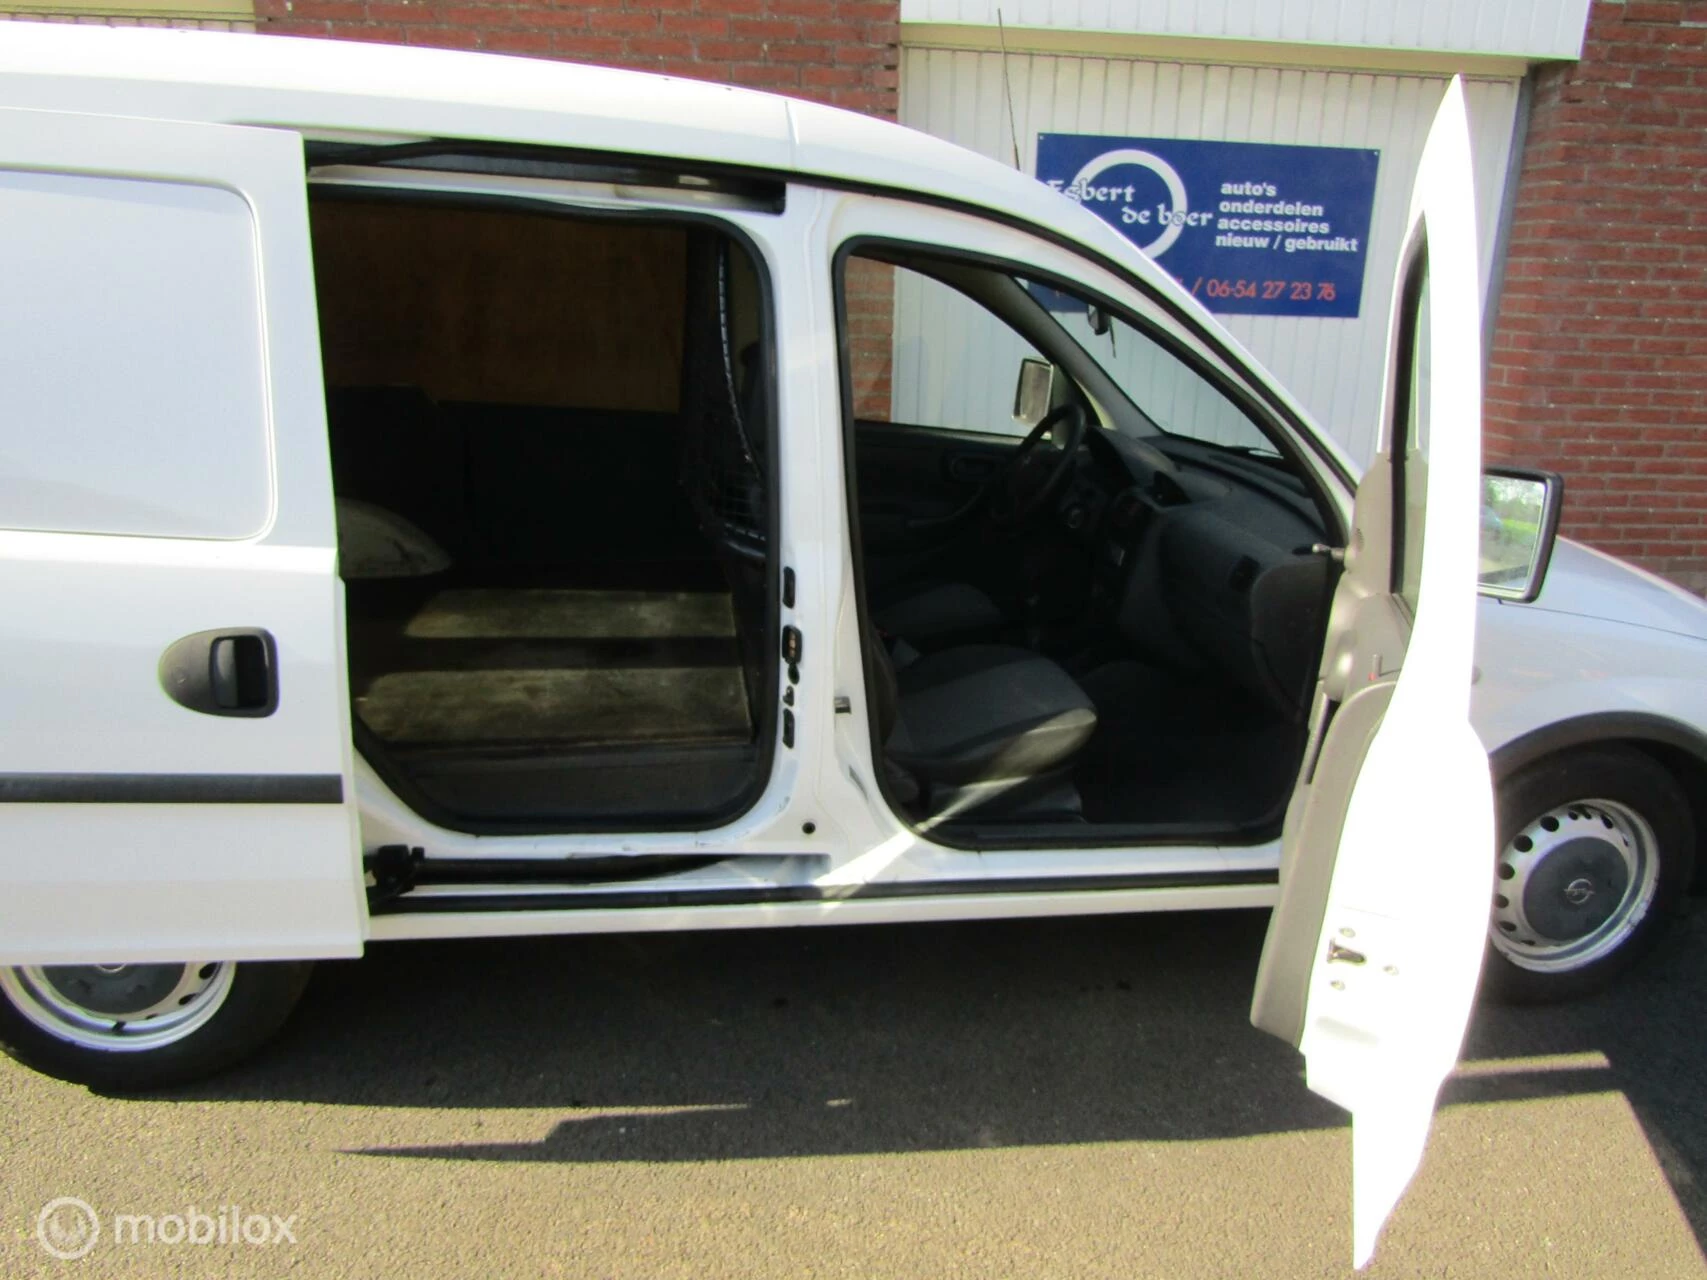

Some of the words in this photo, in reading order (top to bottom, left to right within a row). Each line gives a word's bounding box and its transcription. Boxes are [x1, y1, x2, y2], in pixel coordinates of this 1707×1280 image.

[1220, 182, 1277, 197] auto's
[1121, 206, 1151, 224] de
[1157, 203, 1213, 227] boer
[1219, 200, 1324, 217] onderdelen
[1217, 216, 1330, 234] accessoires
[1215, 232, 1270, 248] nieuw
[1285, 236, 1358, 252] gebruikt
[1206, 279, 1257, 298] 06-54
[1262, 280, 1286, 299] 27
[1290, 281, 1312, 300] 23
